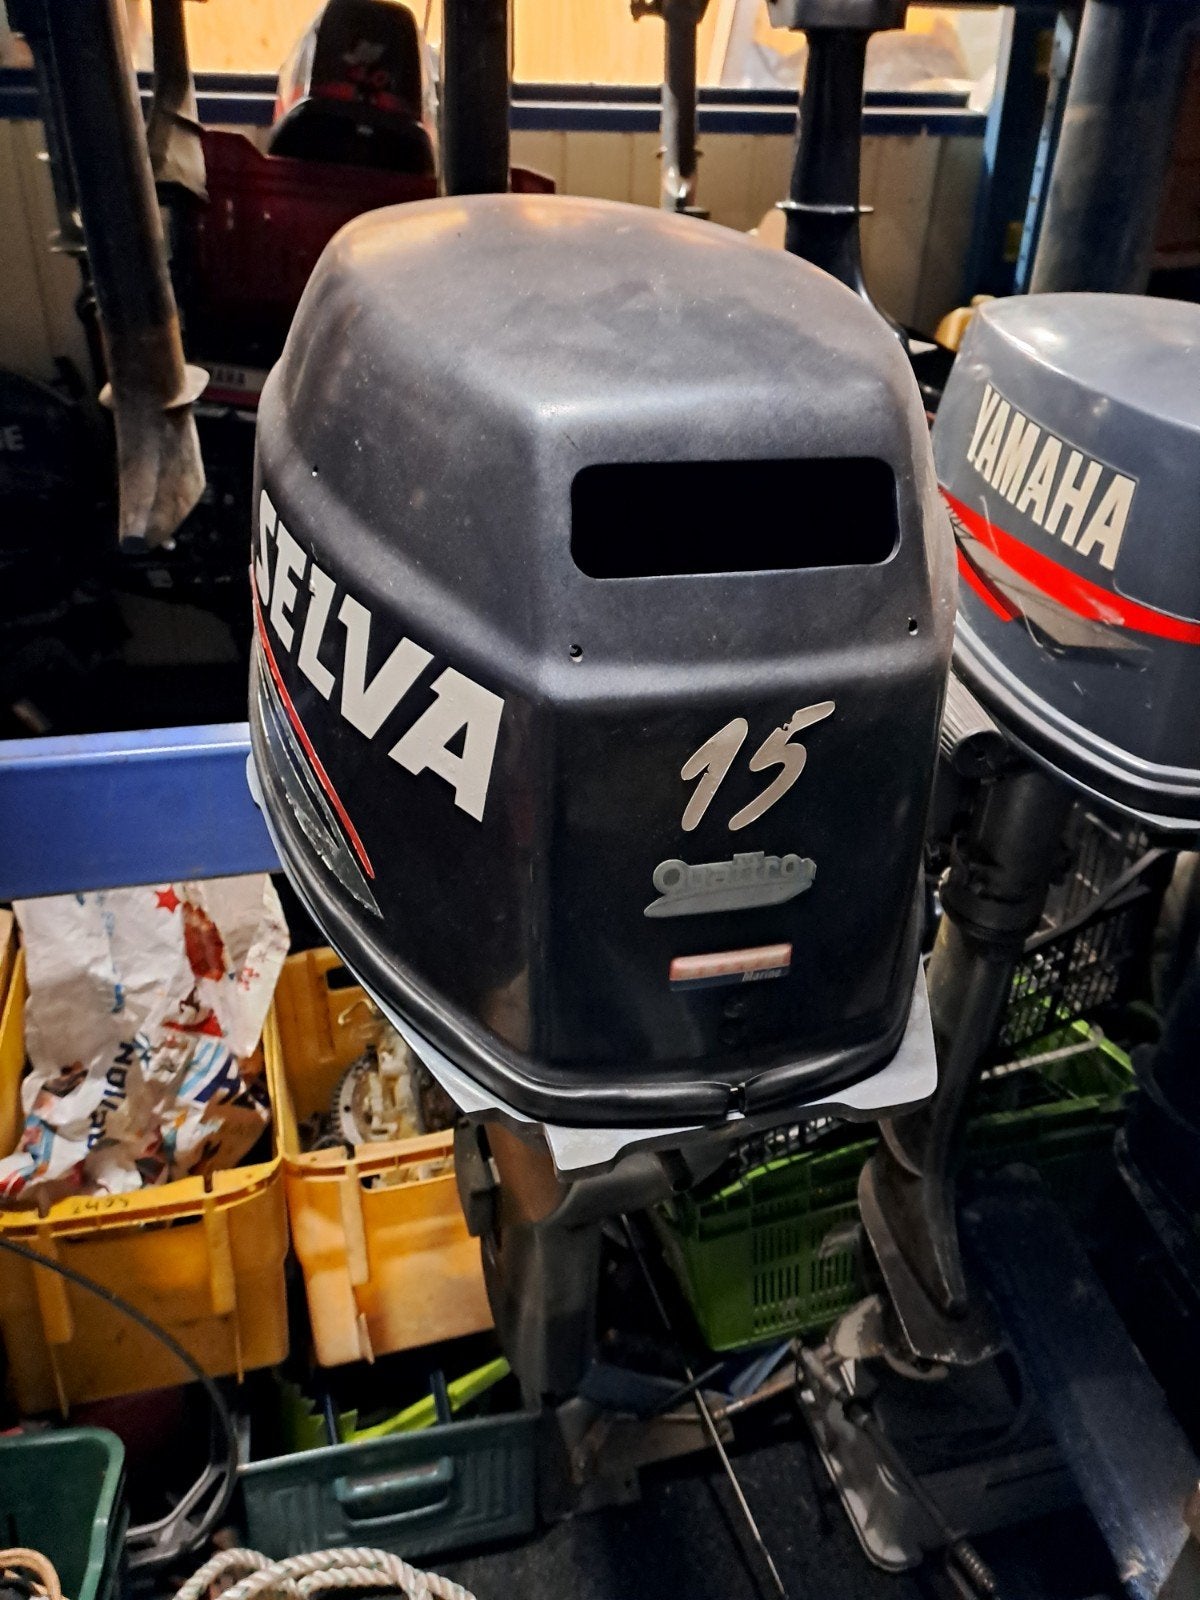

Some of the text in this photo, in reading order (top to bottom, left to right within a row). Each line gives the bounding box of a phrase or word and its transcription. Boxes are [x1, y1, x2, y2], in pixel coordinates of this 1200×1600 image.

[967, 383, 1136, 571] YAMAHA
[254, 490, 504, 822] SELVA
[681, 700, 836, 831] 15
